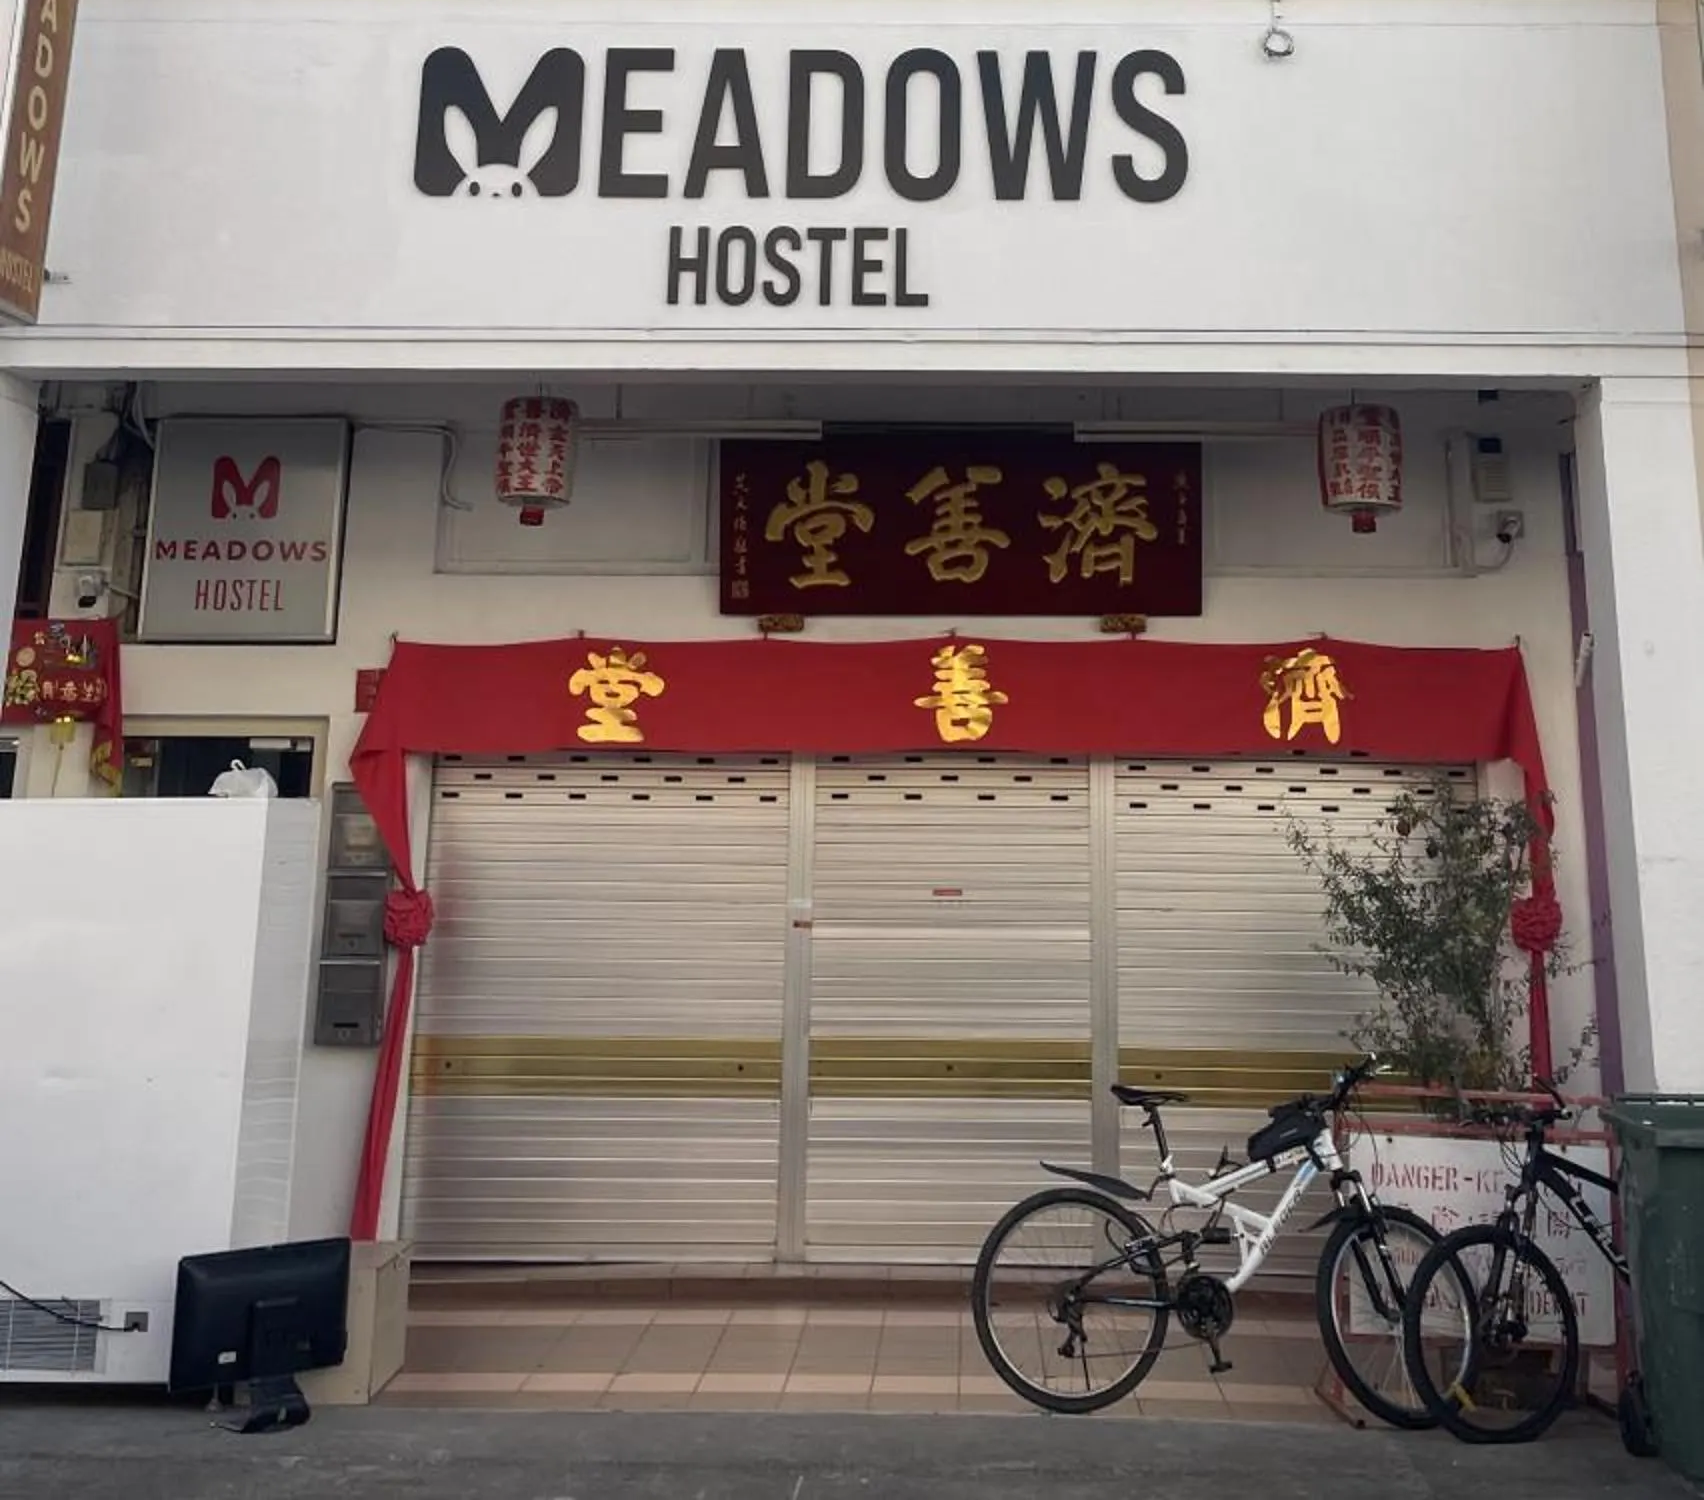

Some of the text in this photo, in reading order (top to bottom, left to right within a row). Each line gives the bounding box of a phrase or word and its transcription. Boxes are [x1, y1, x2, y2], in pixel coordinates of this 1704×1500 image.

[413, 45, 1189, 204] MEADOWS
[665, 225, 929, 307] HOSTEL
[155, 539, 328, 562] MEADOWS
[194, 579, 285, 612] HOSTEL
